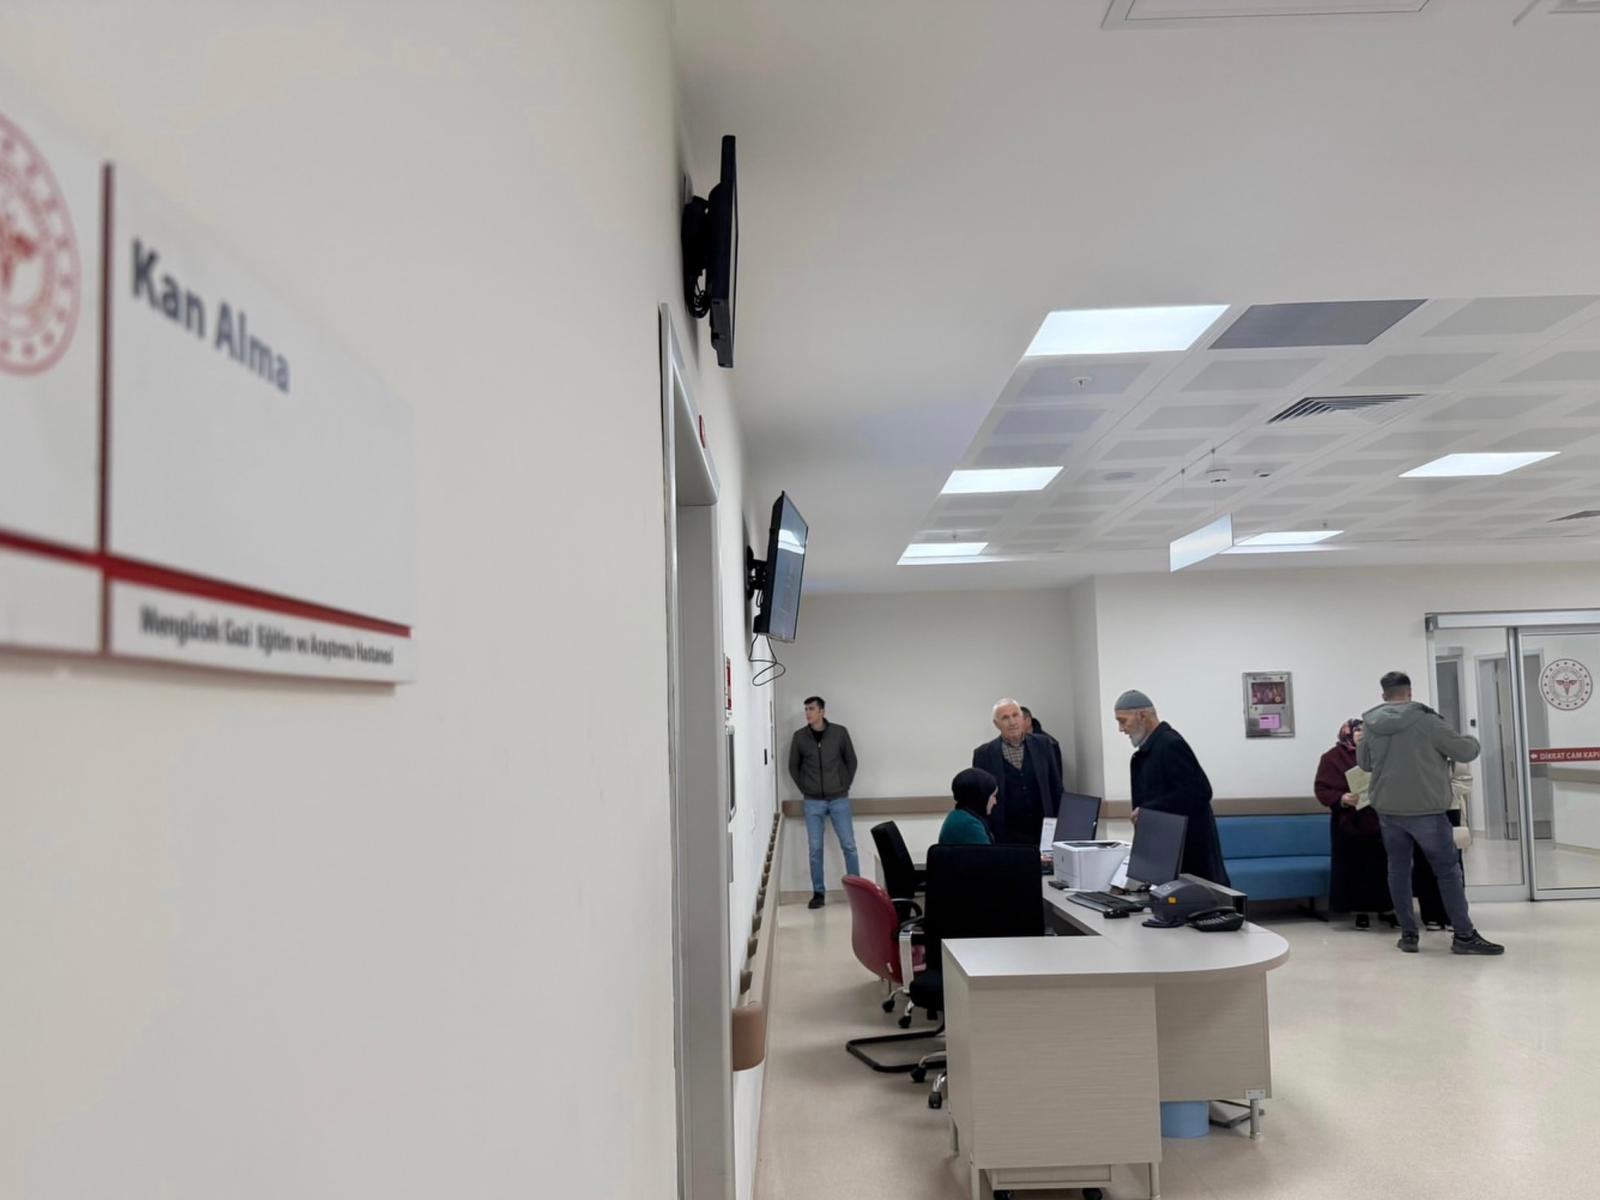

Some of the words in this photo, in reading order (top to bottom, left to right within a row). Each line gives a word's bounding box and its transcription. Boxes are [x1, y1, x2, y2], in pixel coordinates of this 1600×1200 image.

[132, 237, 206, 339] Kan
[214, 302, 290, 394] Alma
[226, 619, 252, 647] Gazi
[297, 636, 307, 654] ve
[356, 641, 394, 664] Hastanesi
